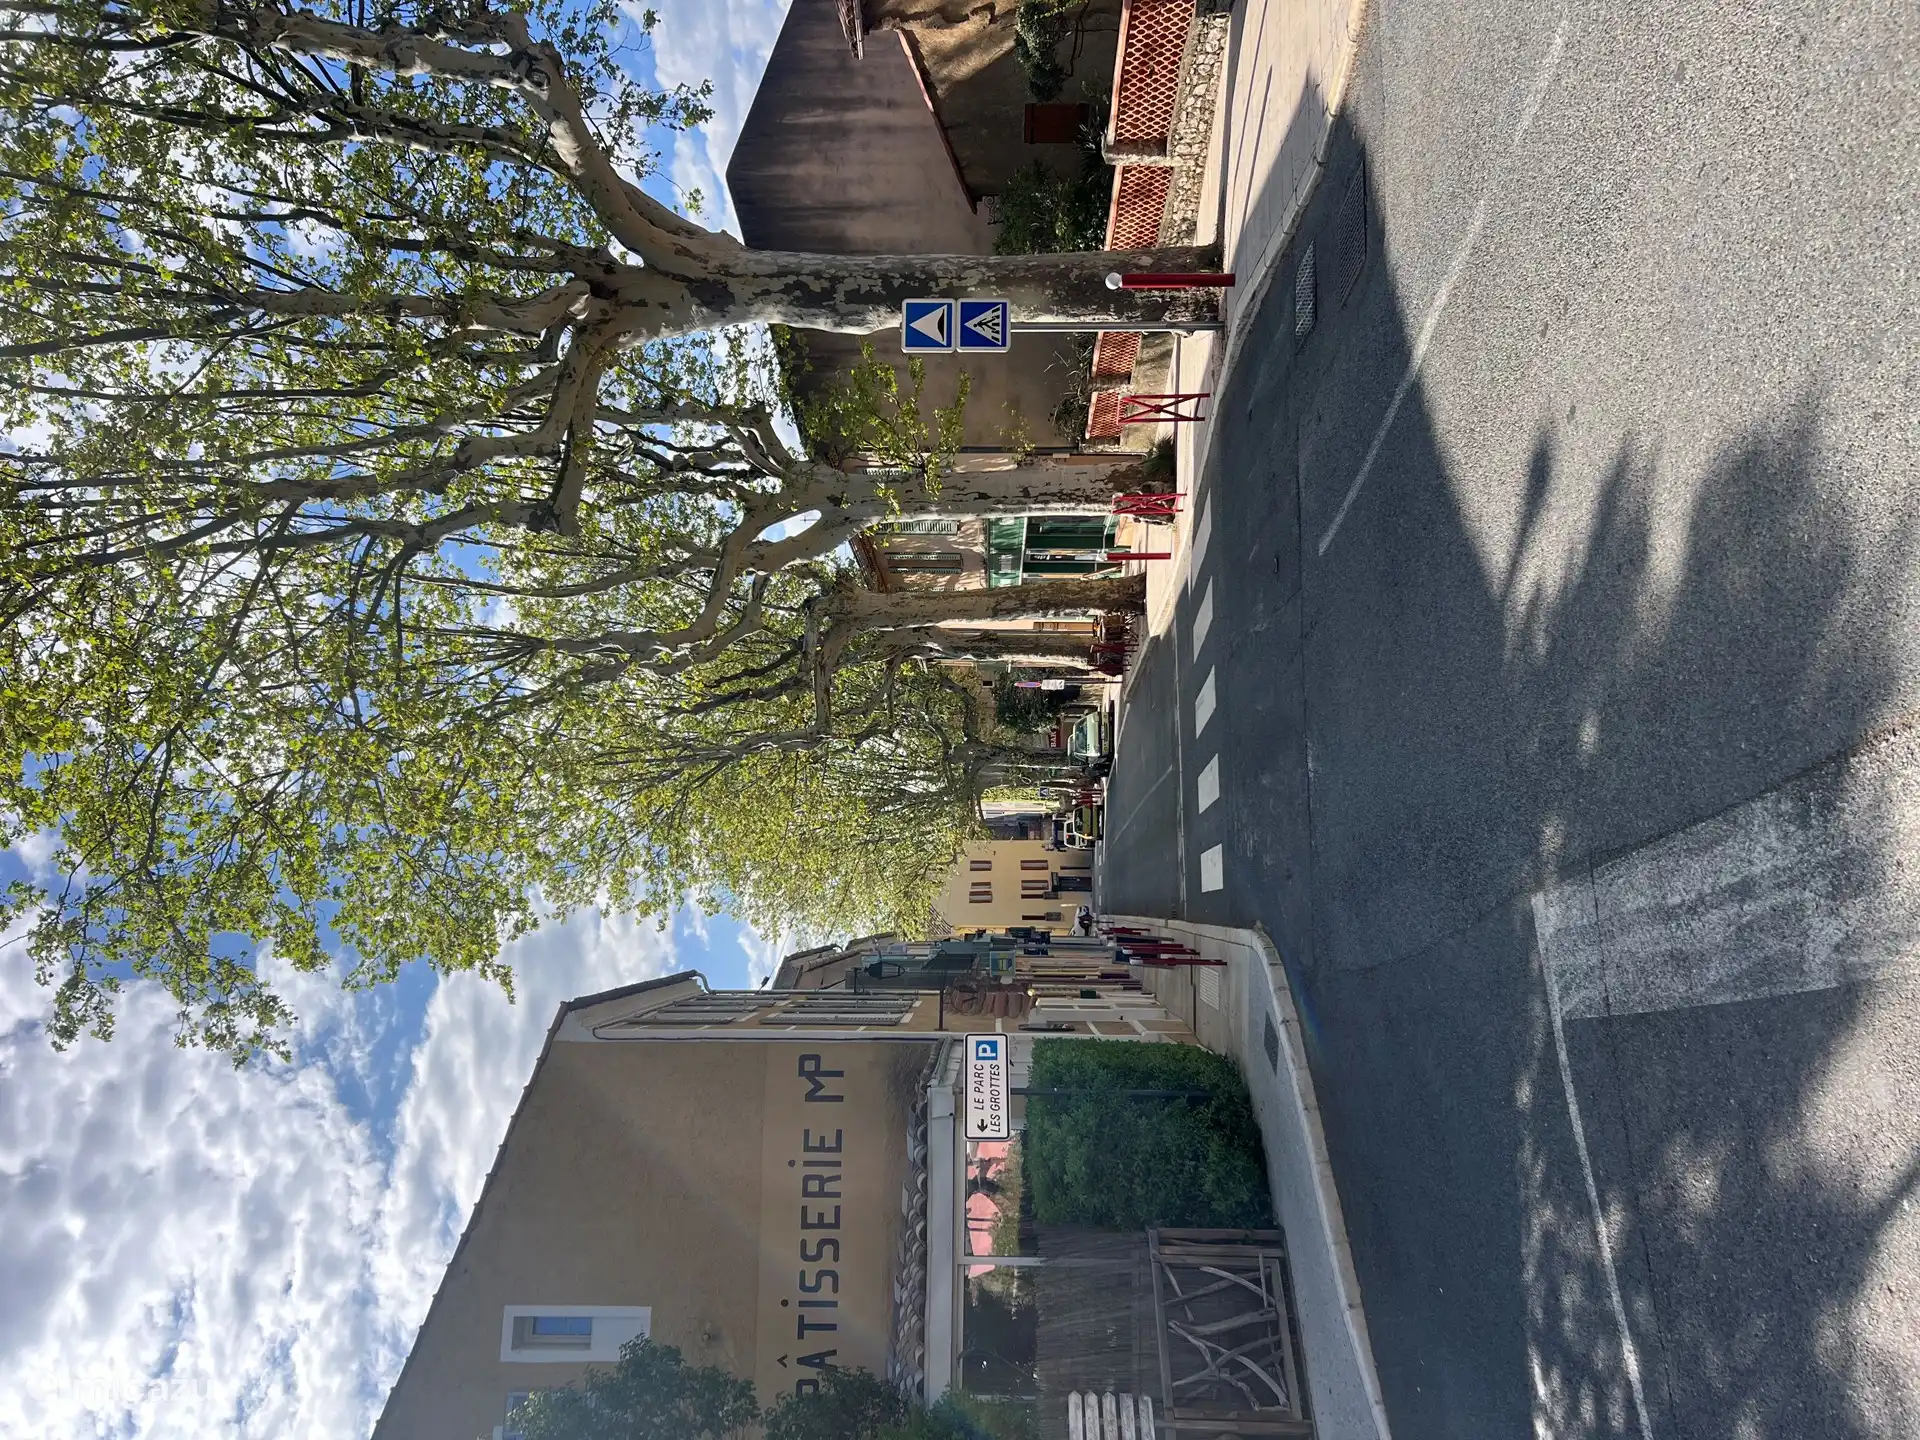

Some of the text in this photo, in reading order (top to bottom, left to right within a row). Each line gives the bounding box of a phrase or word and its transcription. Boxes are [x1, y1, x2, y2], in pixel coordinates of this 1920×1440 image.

[978, 1043, 996, 1057] P
[797, 1053, 845, 1103] MP
[974, 1064, 984, 1110] LE PARC
[990, 1064, 1000, 1132] LES GROTTES
